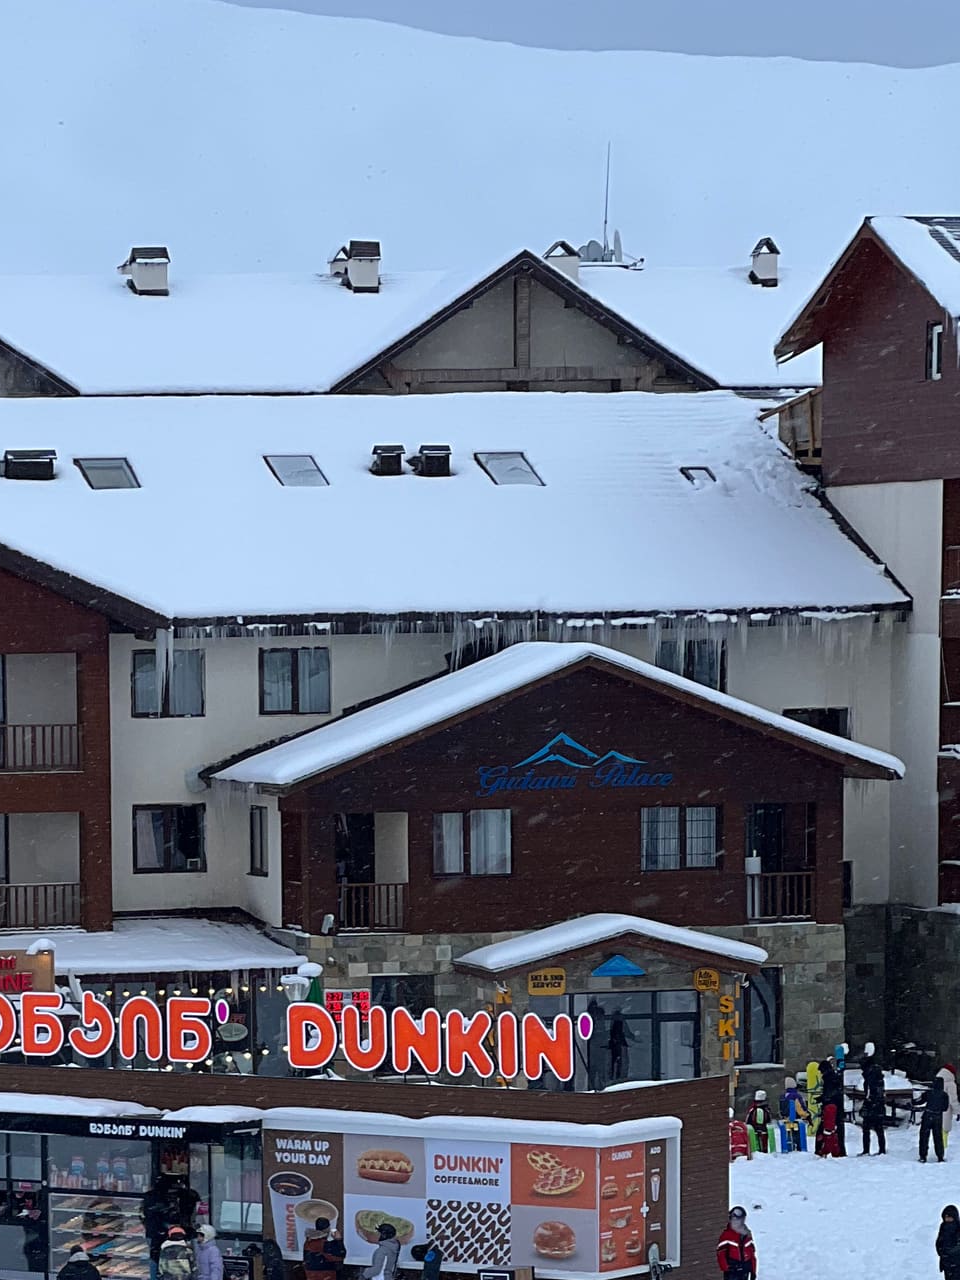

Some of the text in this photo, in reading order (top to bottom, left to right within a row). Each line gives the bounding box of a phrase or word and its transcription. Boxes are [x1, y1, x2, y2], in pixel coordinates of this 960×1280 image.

[590, 762, 673, 788] Palace
[287, 1001, 593, 1082] DUNKIN'
[139, 1125, 187, 1139] DUNKIN'
[275, 1138, 329, 1152] WARM UP
[275, 1152, 331, 1165] YOUR DAY
[433, 1154, 503, 1174] DUNKIN'
